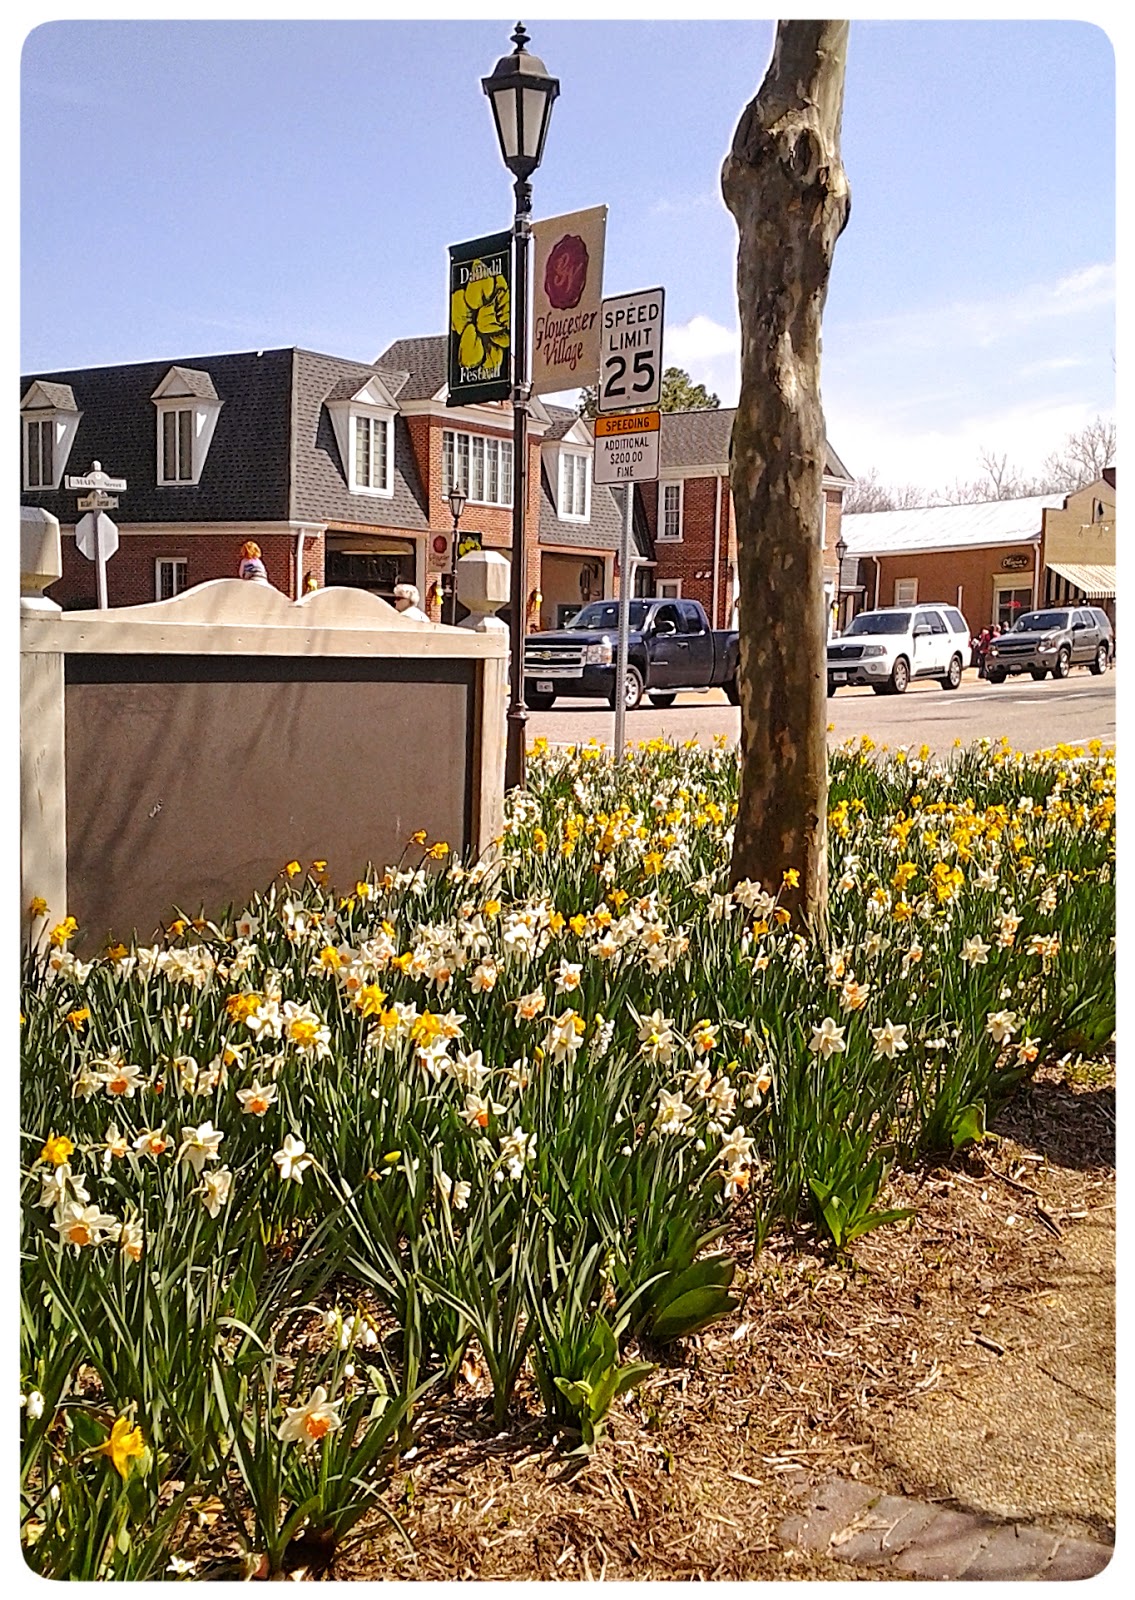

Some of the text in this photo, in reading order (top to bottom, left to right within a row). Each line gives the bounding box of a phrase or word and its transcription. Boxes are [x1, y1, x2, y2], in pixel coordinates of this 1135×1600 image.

[605, 303, 659, 328] SPEED
[535, 311, 598, 350] Gloucester
[609, 327, 652, 351] LIMIT
[543, 335, 583, 371] Village
[604, 350, 655, 397] 25
[605, 416, 650, 432] SPEEDING
[604, 436, 650, 451] ADDITIONAL
[616, 465, 634, 478] FINE
